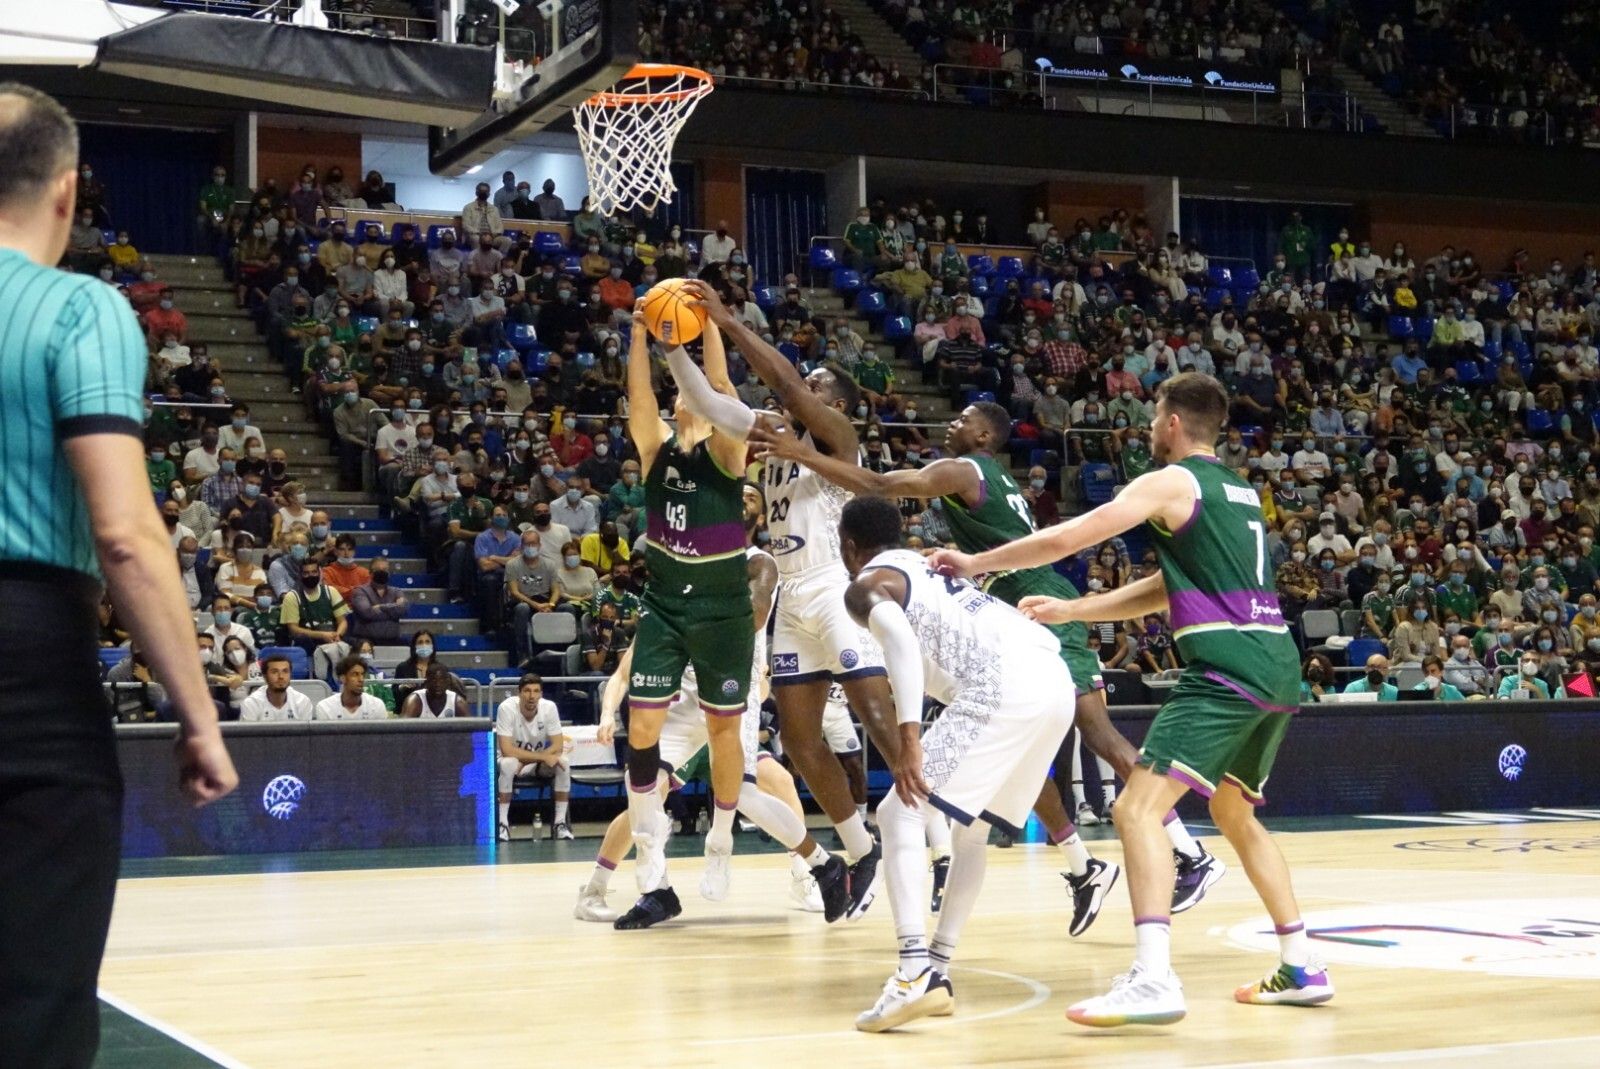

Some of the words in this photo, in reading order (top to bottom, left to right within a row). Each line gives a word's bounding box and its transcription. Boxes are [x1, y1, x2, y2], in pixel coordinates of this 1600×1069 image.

[666, 502, 686, 531] 43
[771, 497, 790, 522] 20
[1247, 520, 1264, 586] 7
